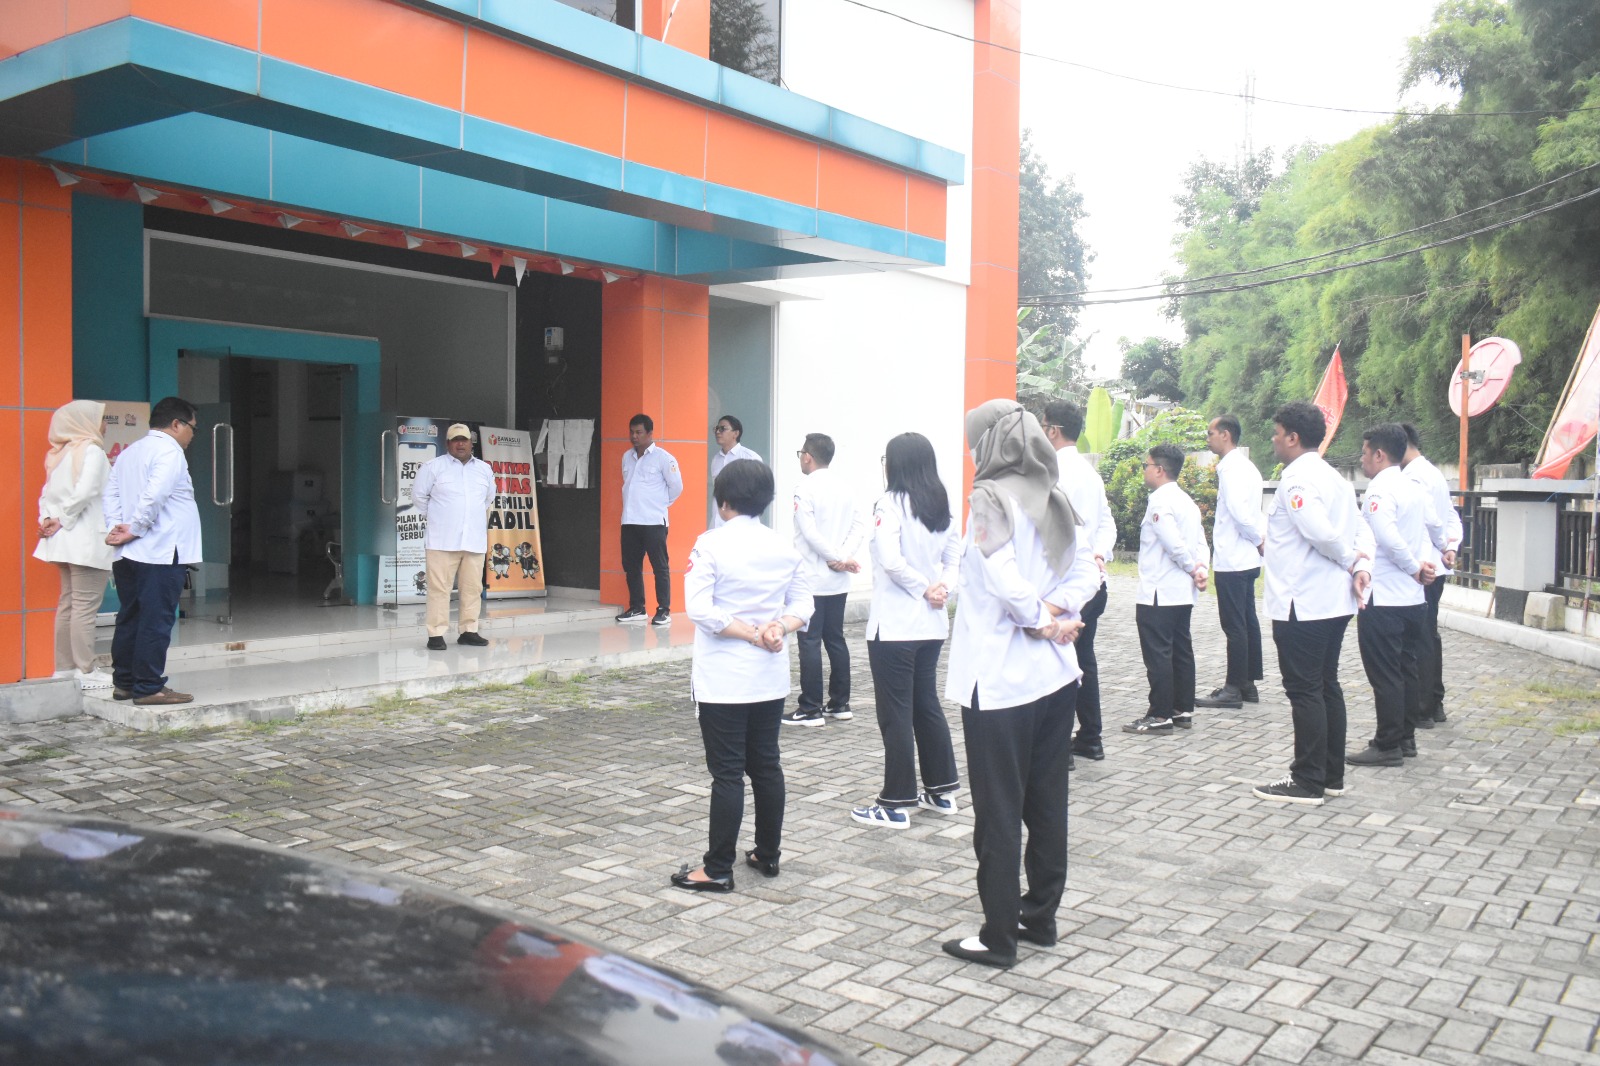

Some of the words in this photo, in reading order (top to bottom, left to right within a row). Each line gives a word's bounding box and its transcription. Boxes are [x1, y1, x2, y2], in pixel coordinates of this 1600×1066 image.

[402, 462, 423, 471] STO
[495, 477, 531, 494] WAS
[491, 496, 533, 509] EMILU
[488, 511, 535, 529] ADIL
[400, 531, 423, 540] SERBU
